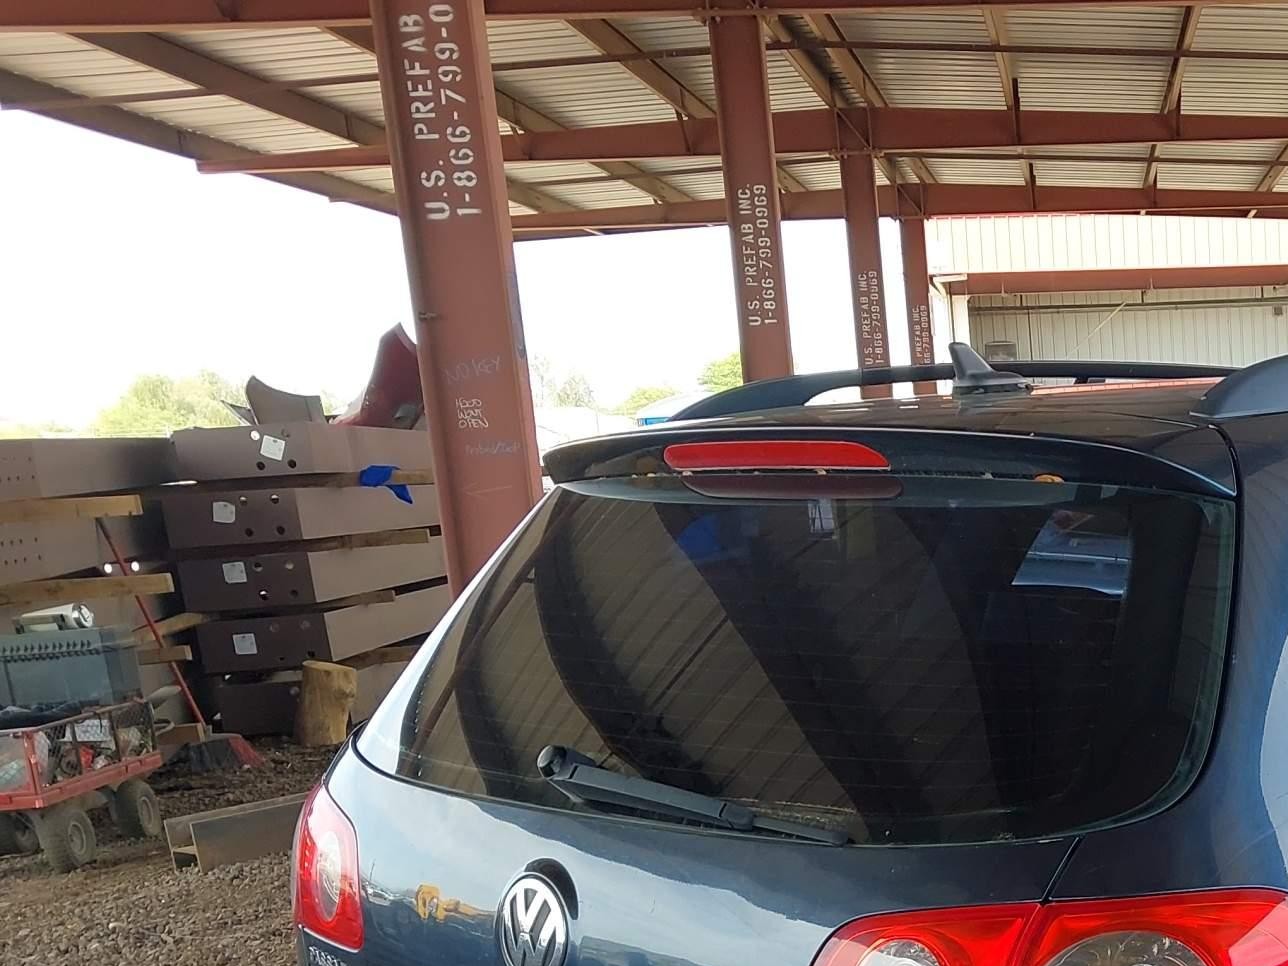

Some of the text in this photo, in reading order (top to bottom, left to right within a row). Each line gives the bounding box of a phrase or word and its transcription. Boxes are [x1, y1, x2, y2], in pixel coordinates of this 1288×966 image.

[400, 14, 450, 220] U.S. PREFAB
[428, 4, 482, 216] 1-866-799-0
[738, 183, 762, 326] U.S. PREFAB INC.
[753, 184, 777, 325] 1-866-799-0969
[859, 297, 871, 338] PREFAB
